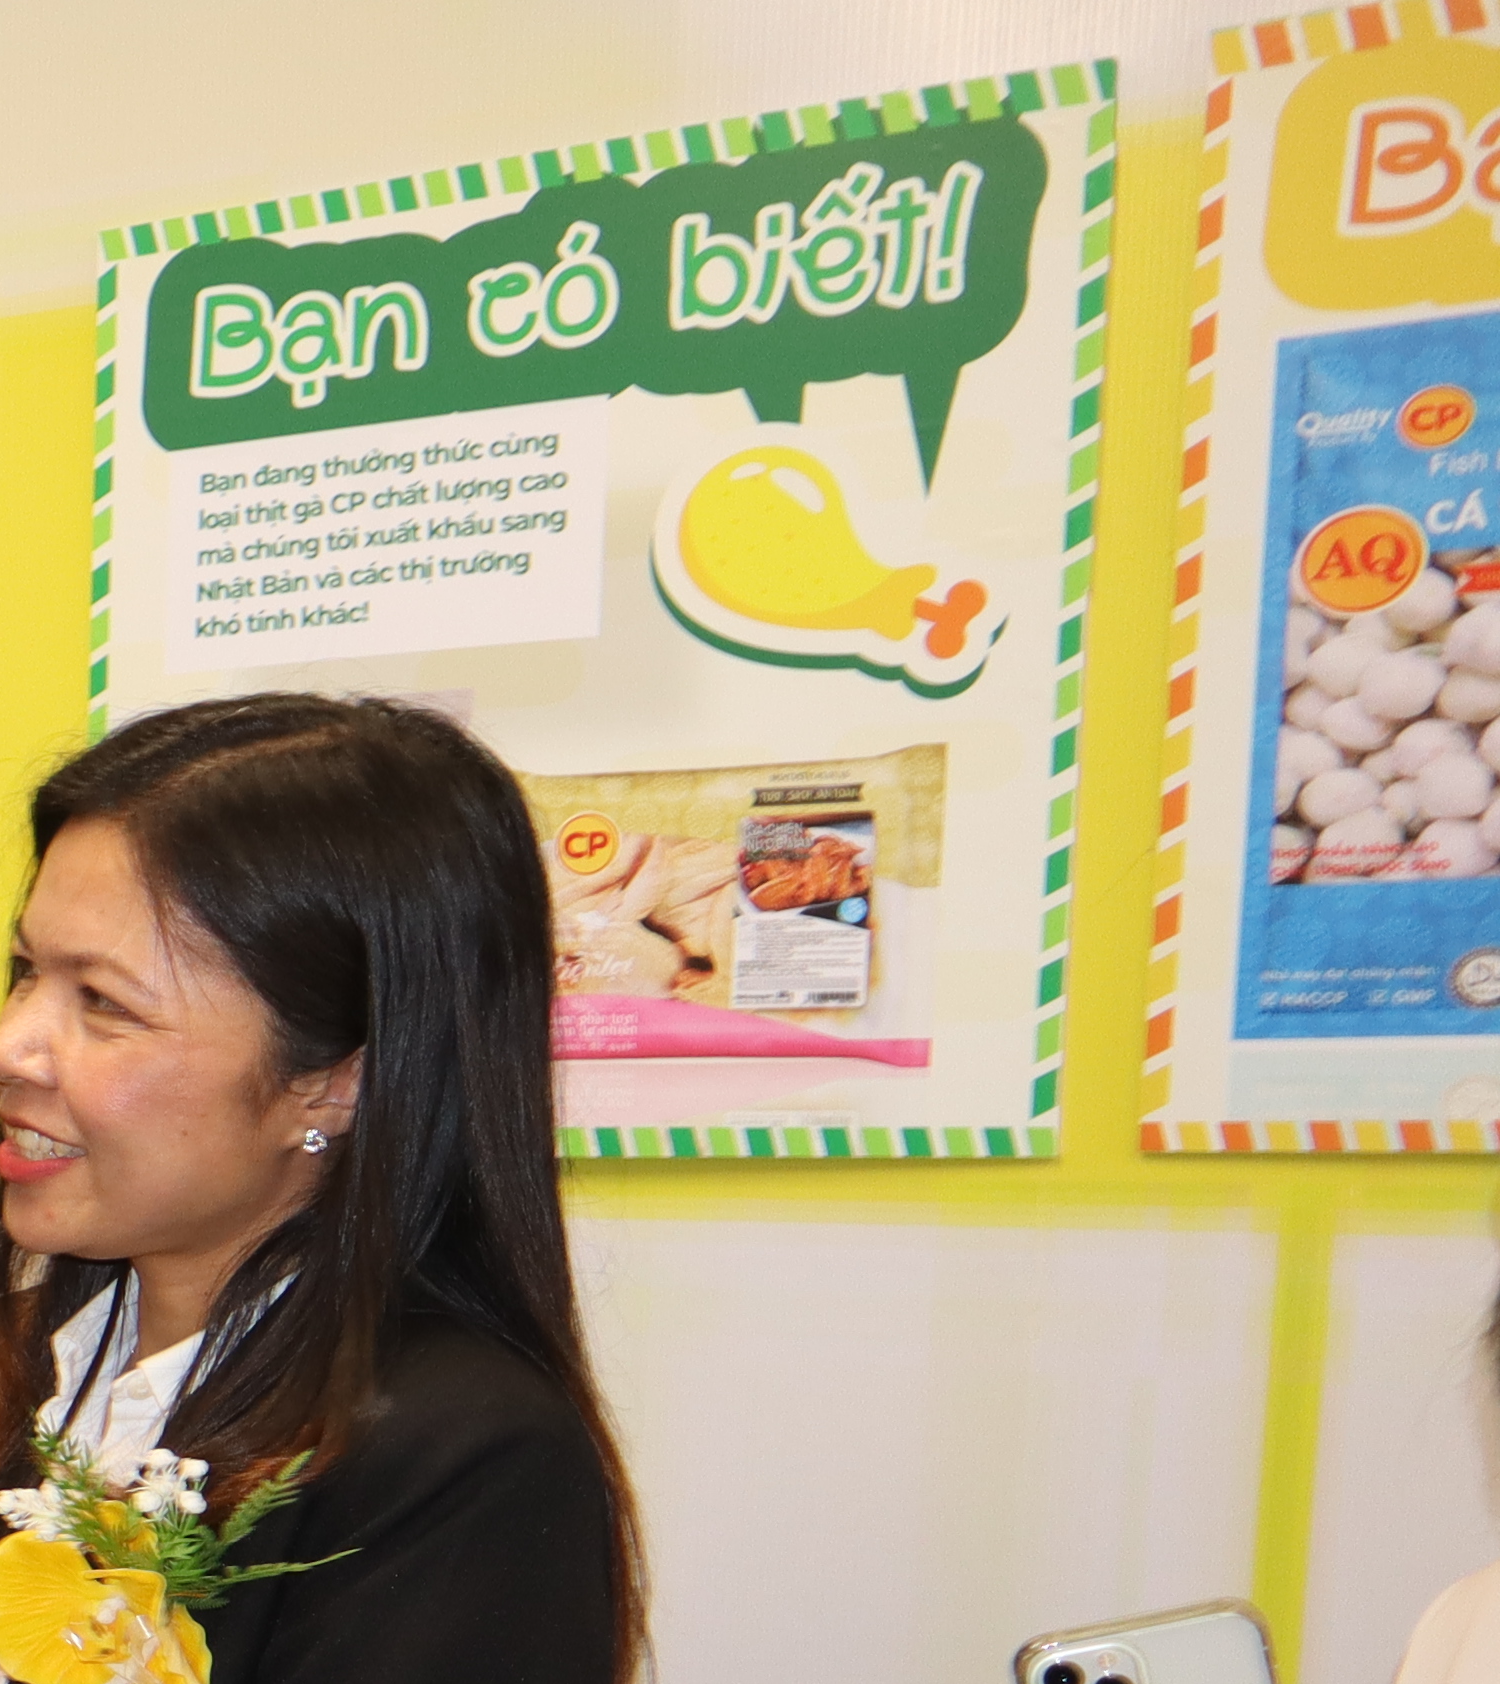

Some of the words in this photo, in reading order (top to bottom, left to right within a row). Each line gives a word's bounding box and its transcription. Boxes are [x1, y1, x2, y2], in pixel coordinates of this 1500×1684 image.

[189, 278, 428, 409] Bạn
[468, 224, 619, 355] có
[670, 162, 982, 329] biết!
[1410, 403, 1462, 432] CP
[200, 472, 247, 498] Bạn
[254, 464, 316, 488] đang
[423, 440, 483, 463] thức
[198, 507, 239, 535] loại
[245, 501, 286, 527] thịt
[294, 496, 323, 523] gà
[330, 492, 366, 514] CP
[371, 479, 428, 509] chất
[435, 473, 511, 505] lượng
[519, 471, 568, 493] cao
[196, 543, 235, 566] mà
[241, 534, 320, 560] chúng
[327, 527, 357, 552] tôi
[364, 516, 421, 547] xuất
[500, 509, 567, 533] sang
[1311, 532, 1408, 583] AQ
[196, 579, 254, 604] Nhật
[315, 565, 343, 589] và
[349, 561, 394, 586] các
[399, 556, 432, 585] thị
[195, 610, 242, 637] khó
[246, 605, 295, 633] tính
[301, 601, 370, 628] khác!
[563, 831, 608, 860] CP
